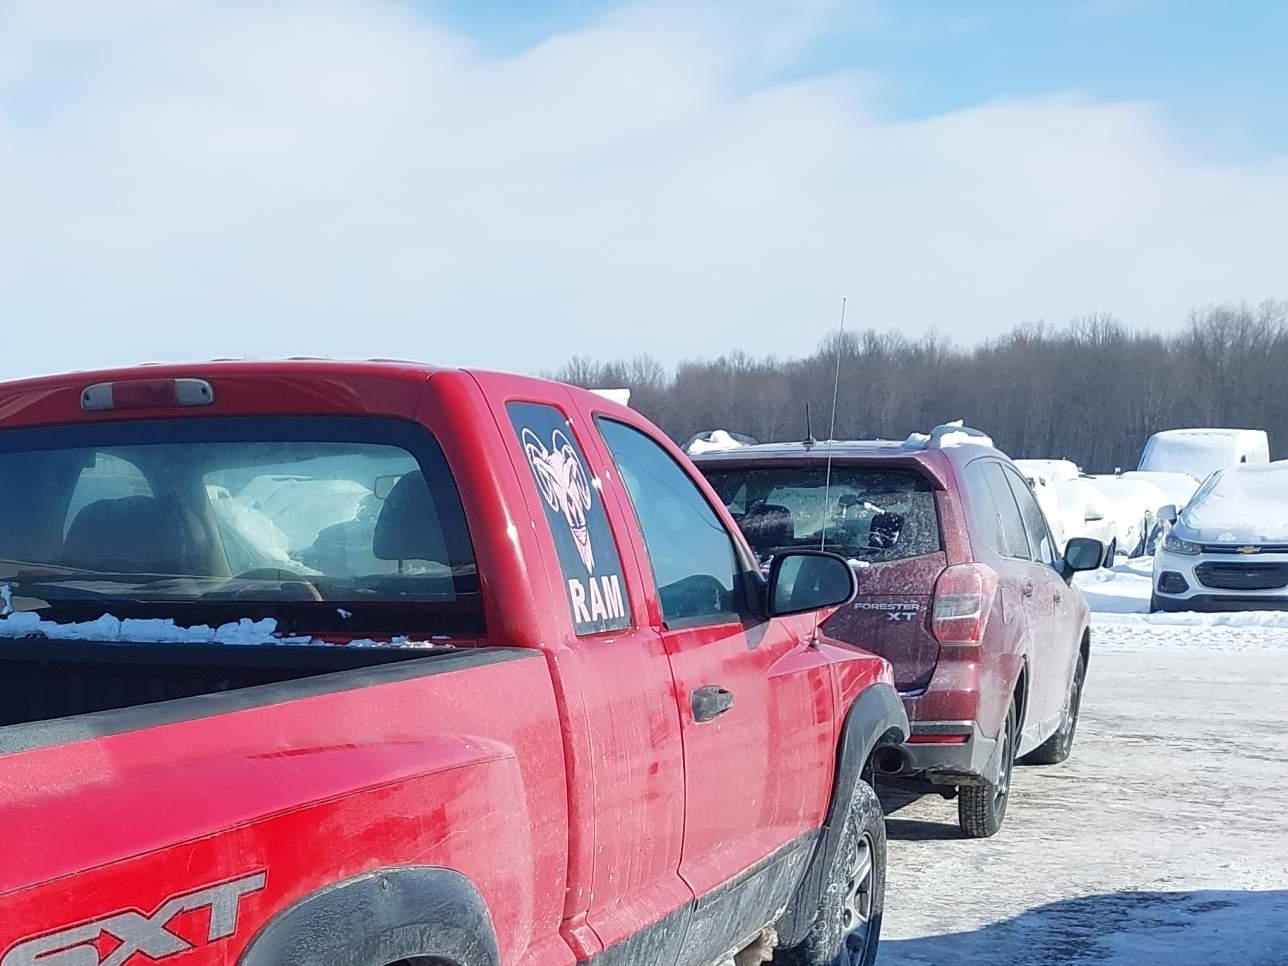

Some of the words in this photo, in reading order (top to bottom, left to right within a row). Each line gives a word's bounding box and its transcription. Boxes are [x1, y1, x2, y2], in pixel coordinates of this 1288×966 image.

[567, 574, 625, 624] RAM
[854, 602, 920, 611] FORESTER
[887, 612, 916, 621] XT
